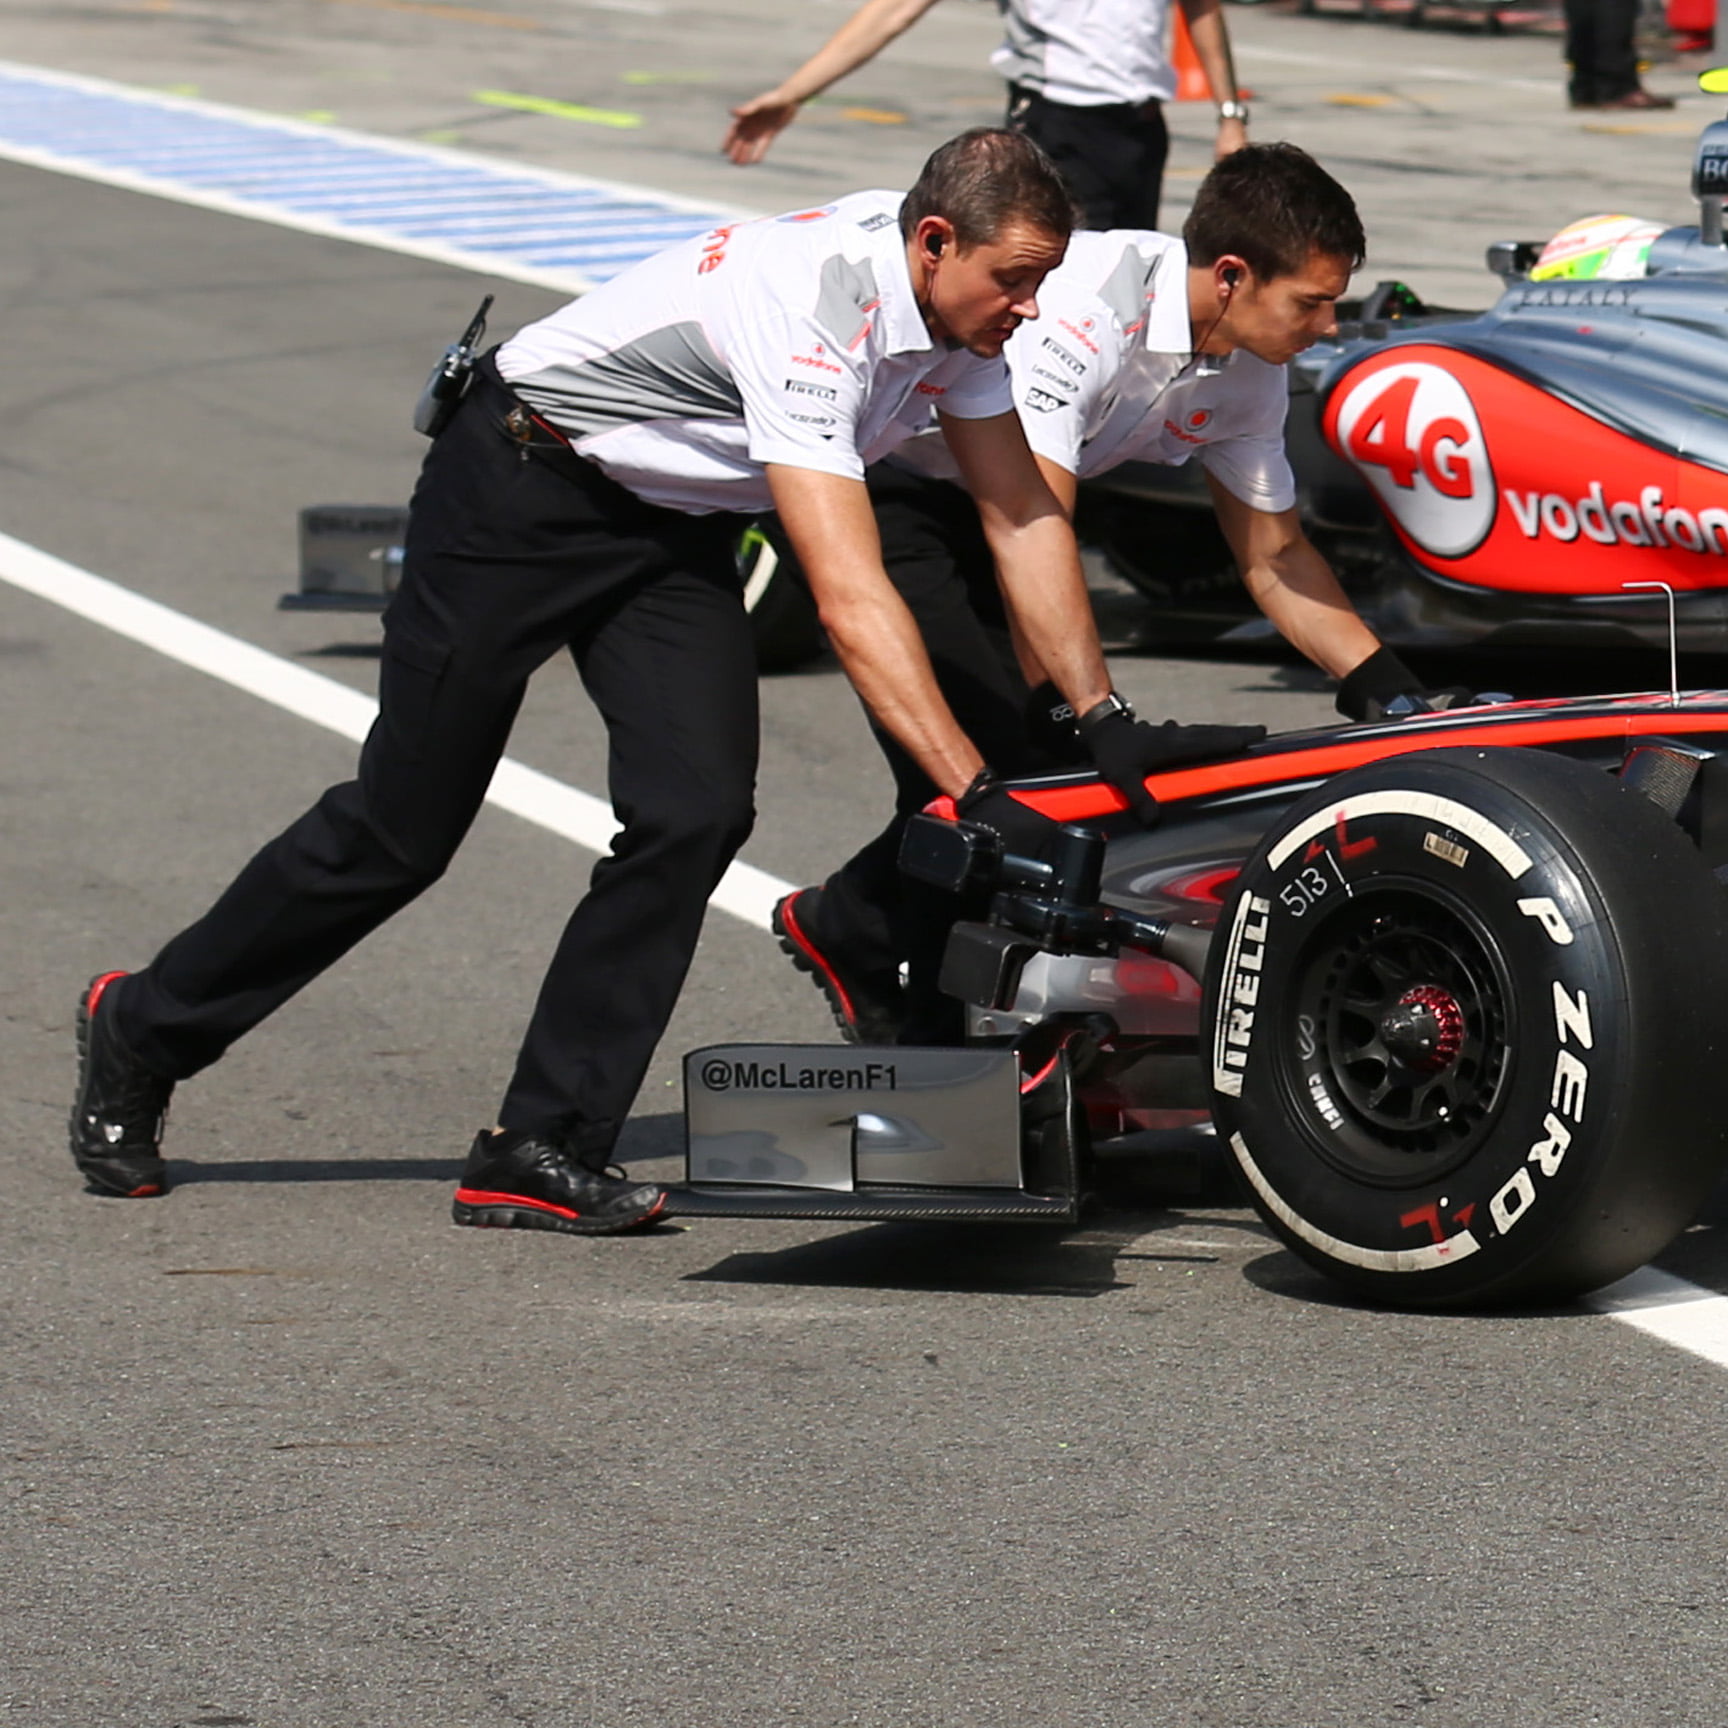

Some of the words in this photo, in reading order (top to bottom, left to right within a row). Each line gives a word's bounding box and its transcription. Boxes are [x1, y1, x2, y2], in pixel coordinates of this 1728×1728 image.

[1520, 289, 1637, 306] EATALY
[1042, 337, 1086, 375] PIRELLI
[1027, 387, 1059, 412] SAP
[1349, 376, 1474, 498] 4G
[1280, 866, 1329, 916] 513
[1517, 896, 1574, 945] P
[1213, 889, 1271, 1098] PIRELLI
[702, 1060, 897, 1092] @McLarenF1
[1489, 980, 1594, 1235] ZERO
